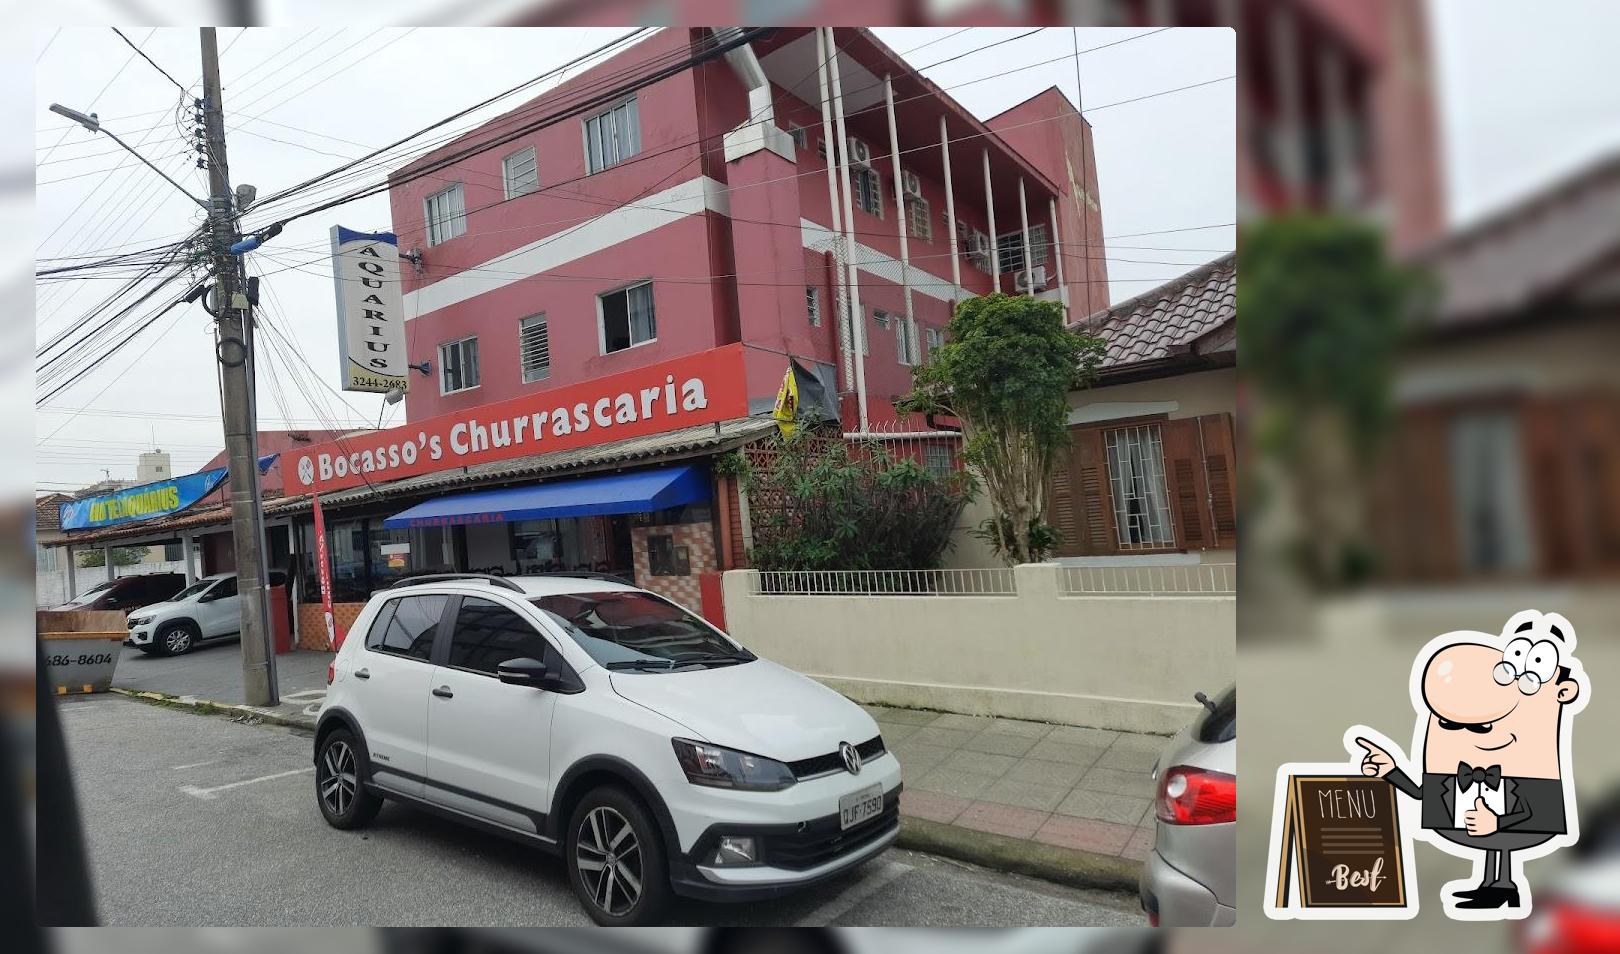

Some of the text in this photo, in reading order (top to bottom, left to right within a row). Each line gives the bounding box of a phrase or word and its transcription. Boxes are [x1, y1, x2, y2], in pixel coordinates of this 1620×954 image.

[358, 247, 390, 368] AQUARIUS
[318, 432, 443, 481] Bocasso's
[449, 375, 708, 456] Churrascaria
[352, 376, 407, 390] 3244-2683
